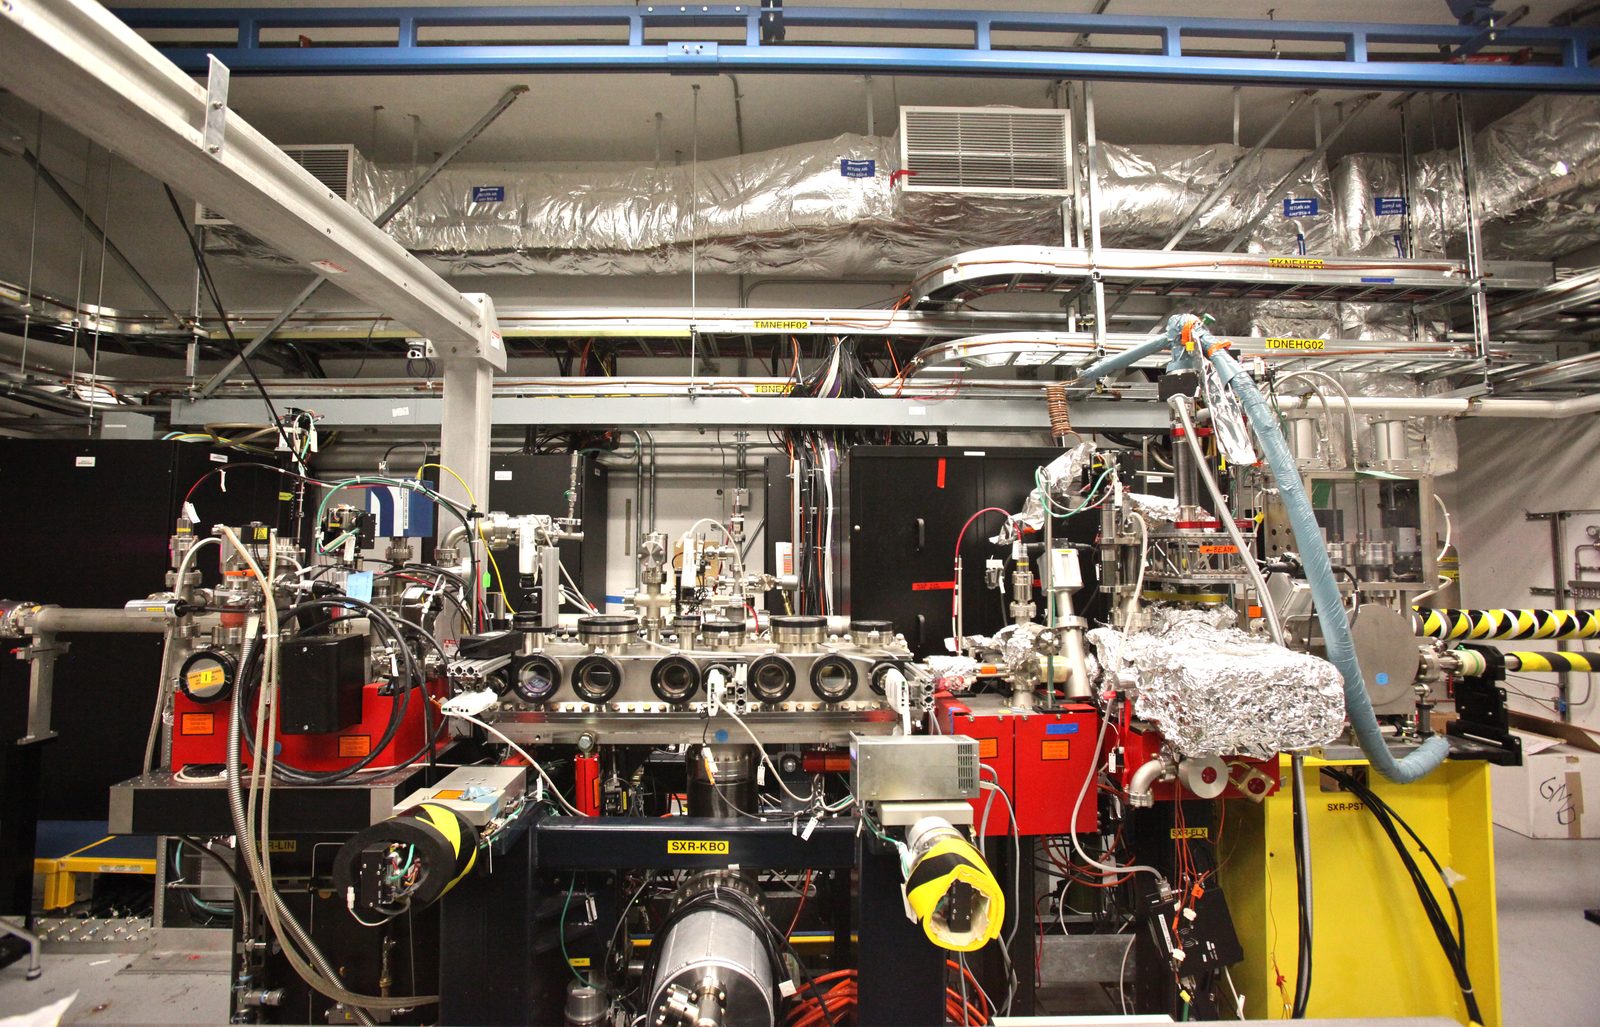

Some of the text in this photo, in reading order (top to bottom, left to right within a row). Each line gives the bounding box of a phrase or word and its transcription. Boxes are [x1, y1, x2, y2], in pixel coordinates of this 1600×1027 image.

[754, 321, 808, 329] TMNEHF02
[1266, 339, 1324, 349] TDNEHG02
[1213, 545, 1234, 554] BEAM
[1327, 802, 1364, 811] SXR-PST
[672, 842, 726, 851] SXR-KBO
